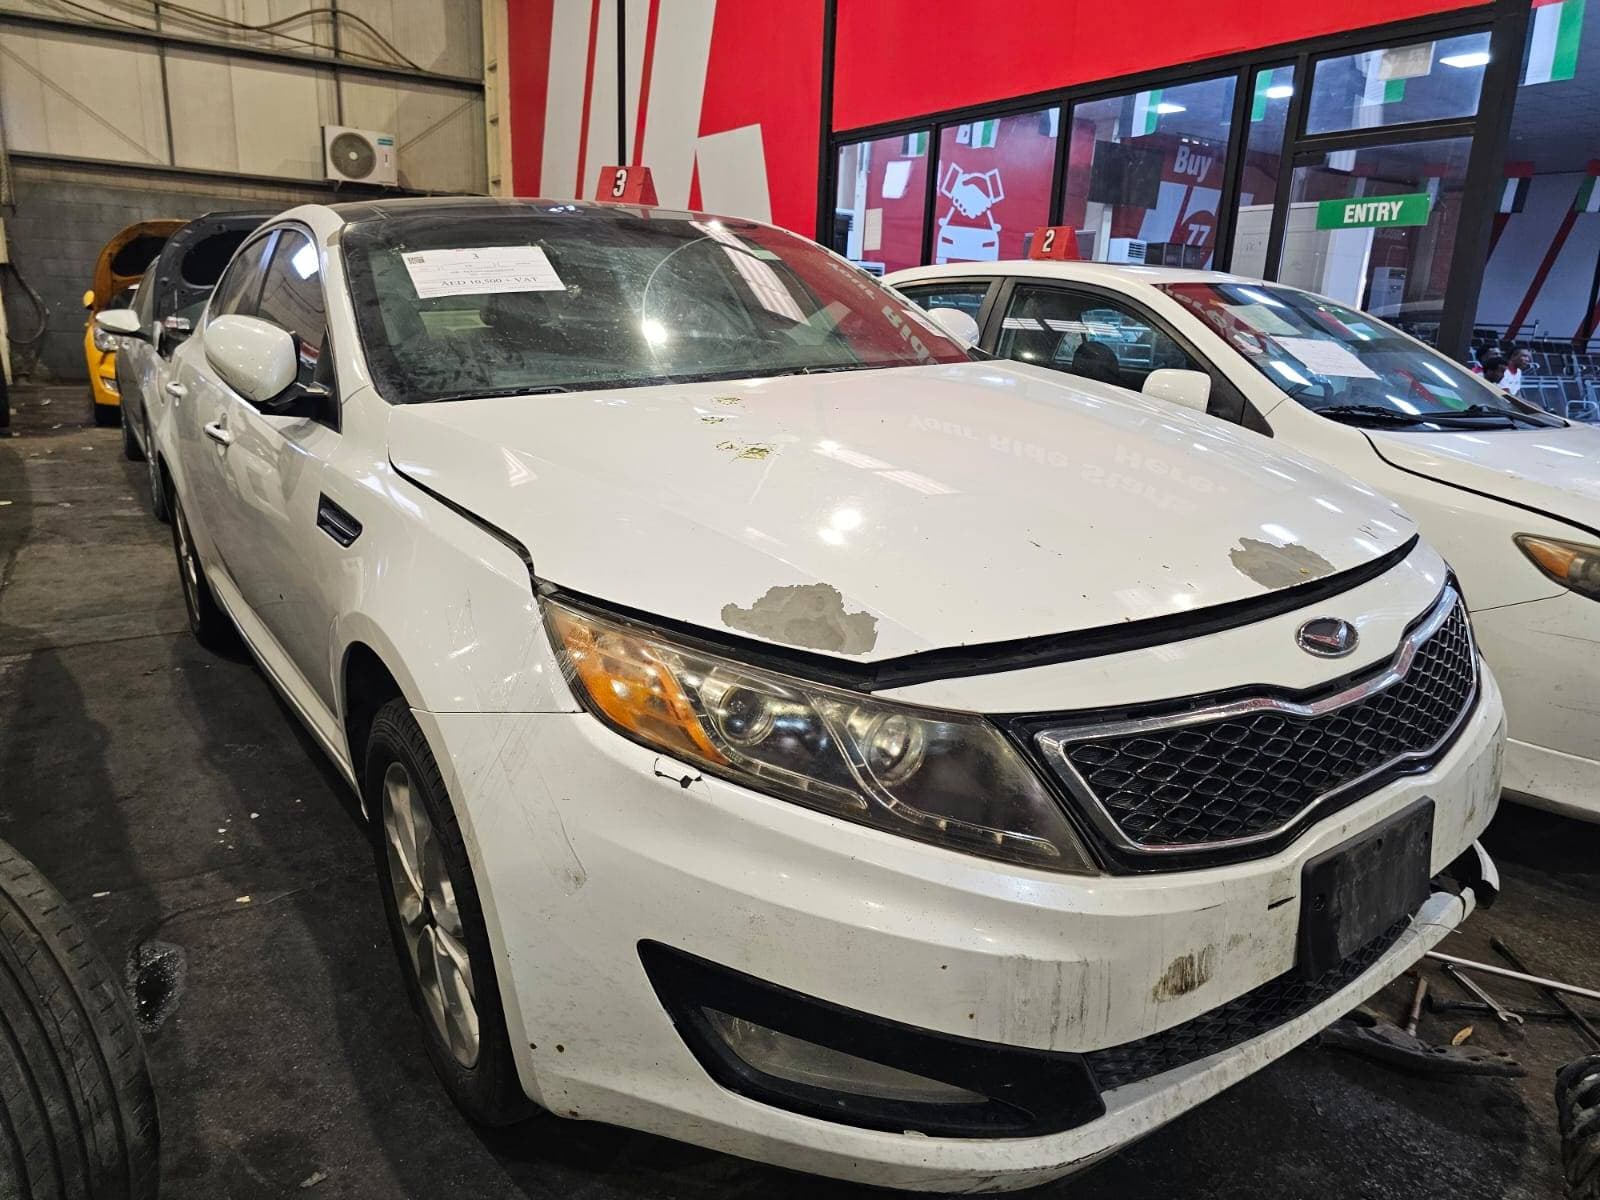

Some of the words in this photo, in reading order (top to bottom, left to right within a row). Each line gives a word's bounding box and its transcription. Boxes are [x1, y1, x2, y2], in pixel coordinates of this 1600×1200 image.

[1173, 145, 1212, 183] Buy
[612, 168, 628, 197] 3
[1343, 200, 1403, 224] ENTRY
[1041, 229, 1056, 252] 2
[1186, 223, 1211, 247] 77
[441, 279, 466, 287] AED
